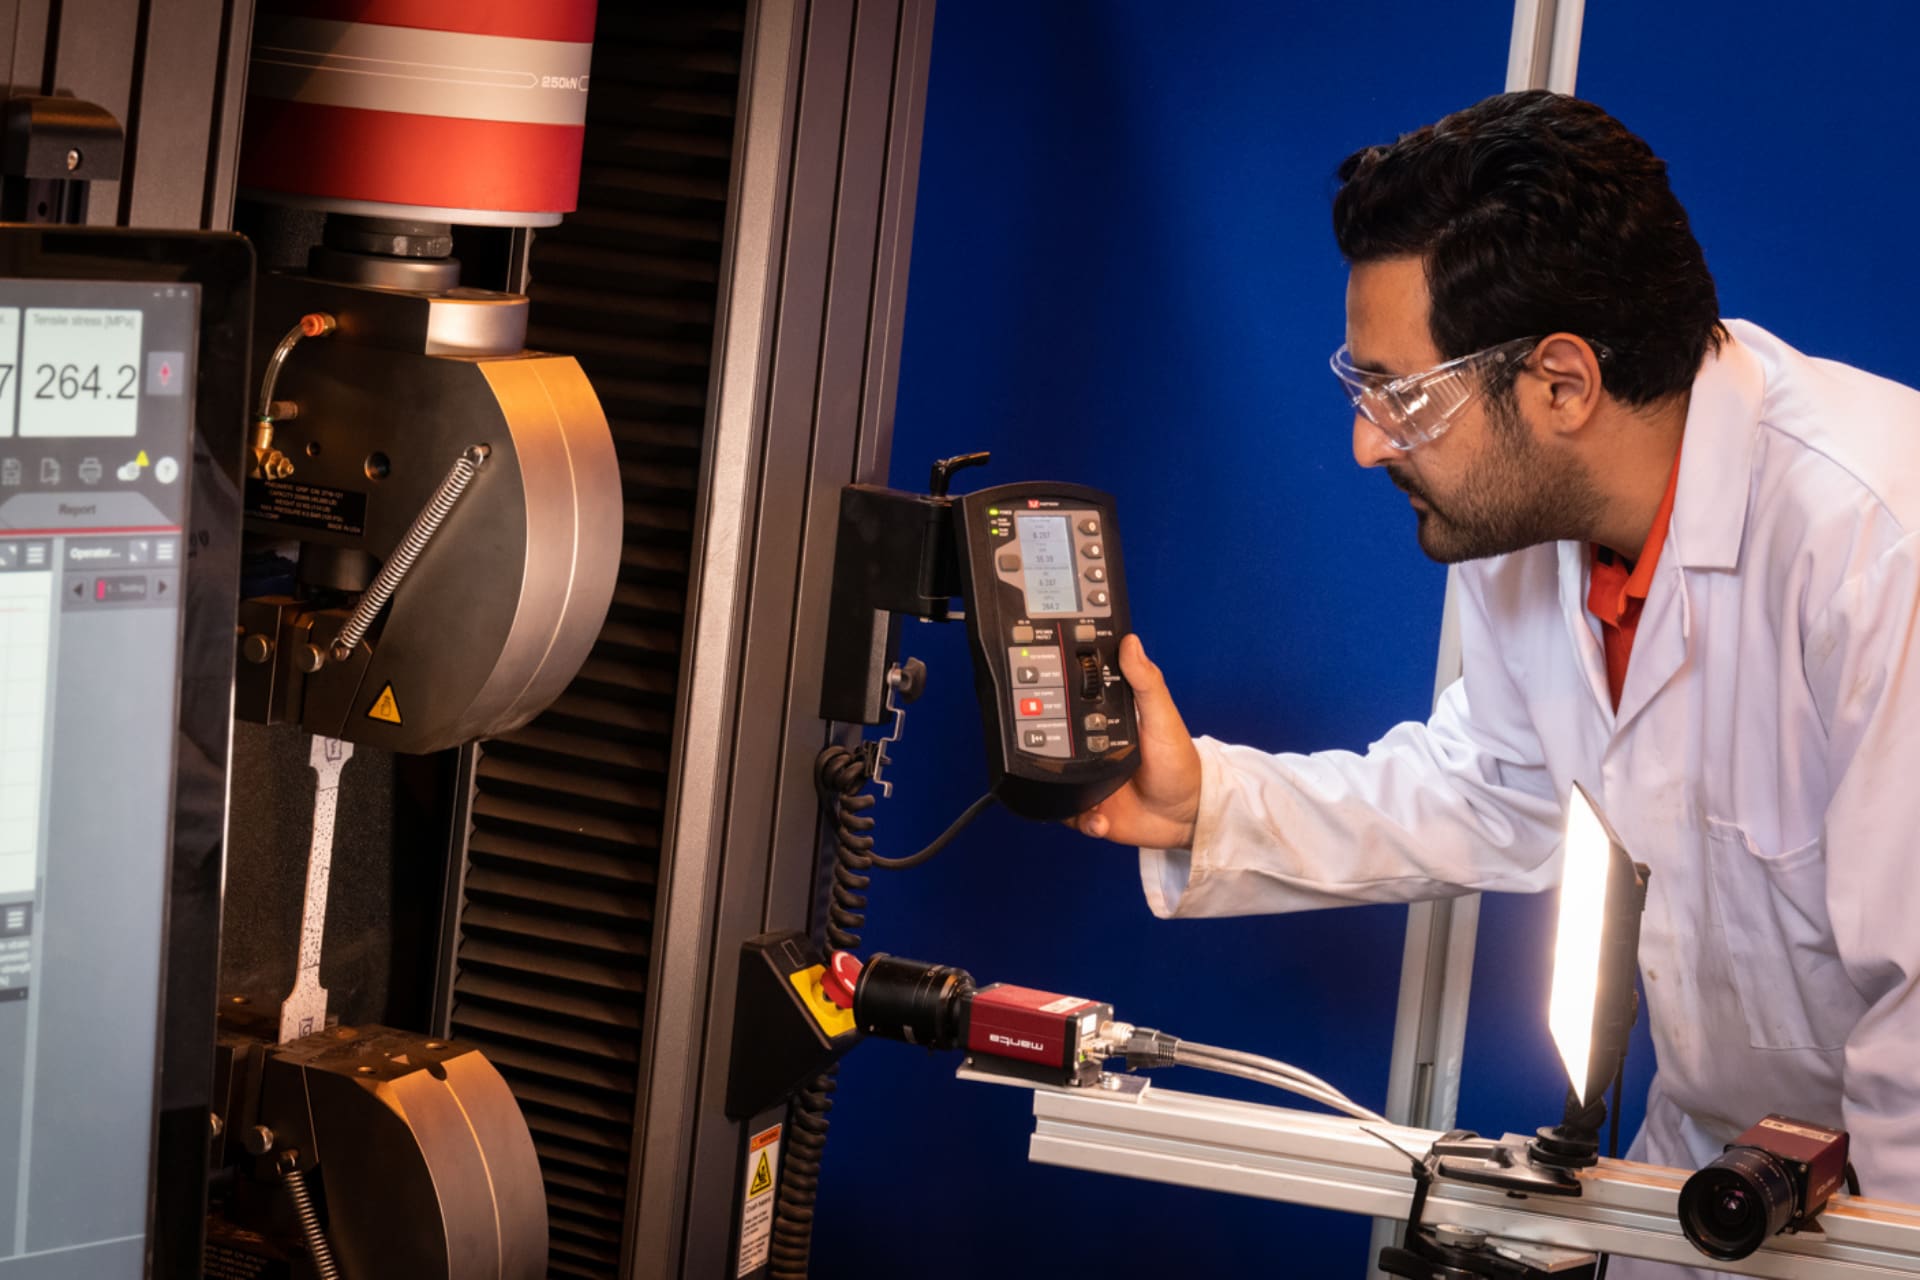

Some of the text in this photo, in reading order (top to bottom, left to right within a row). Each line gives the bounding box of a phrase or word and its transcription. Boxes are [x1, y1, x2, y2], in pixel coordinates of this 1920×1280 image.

[541, 75, 578, 90] 250kN
[34, 363, 137, 400] 264.2
[58, 504, 96, 517] Report
[989, 1033, 1044, 1051] manta
